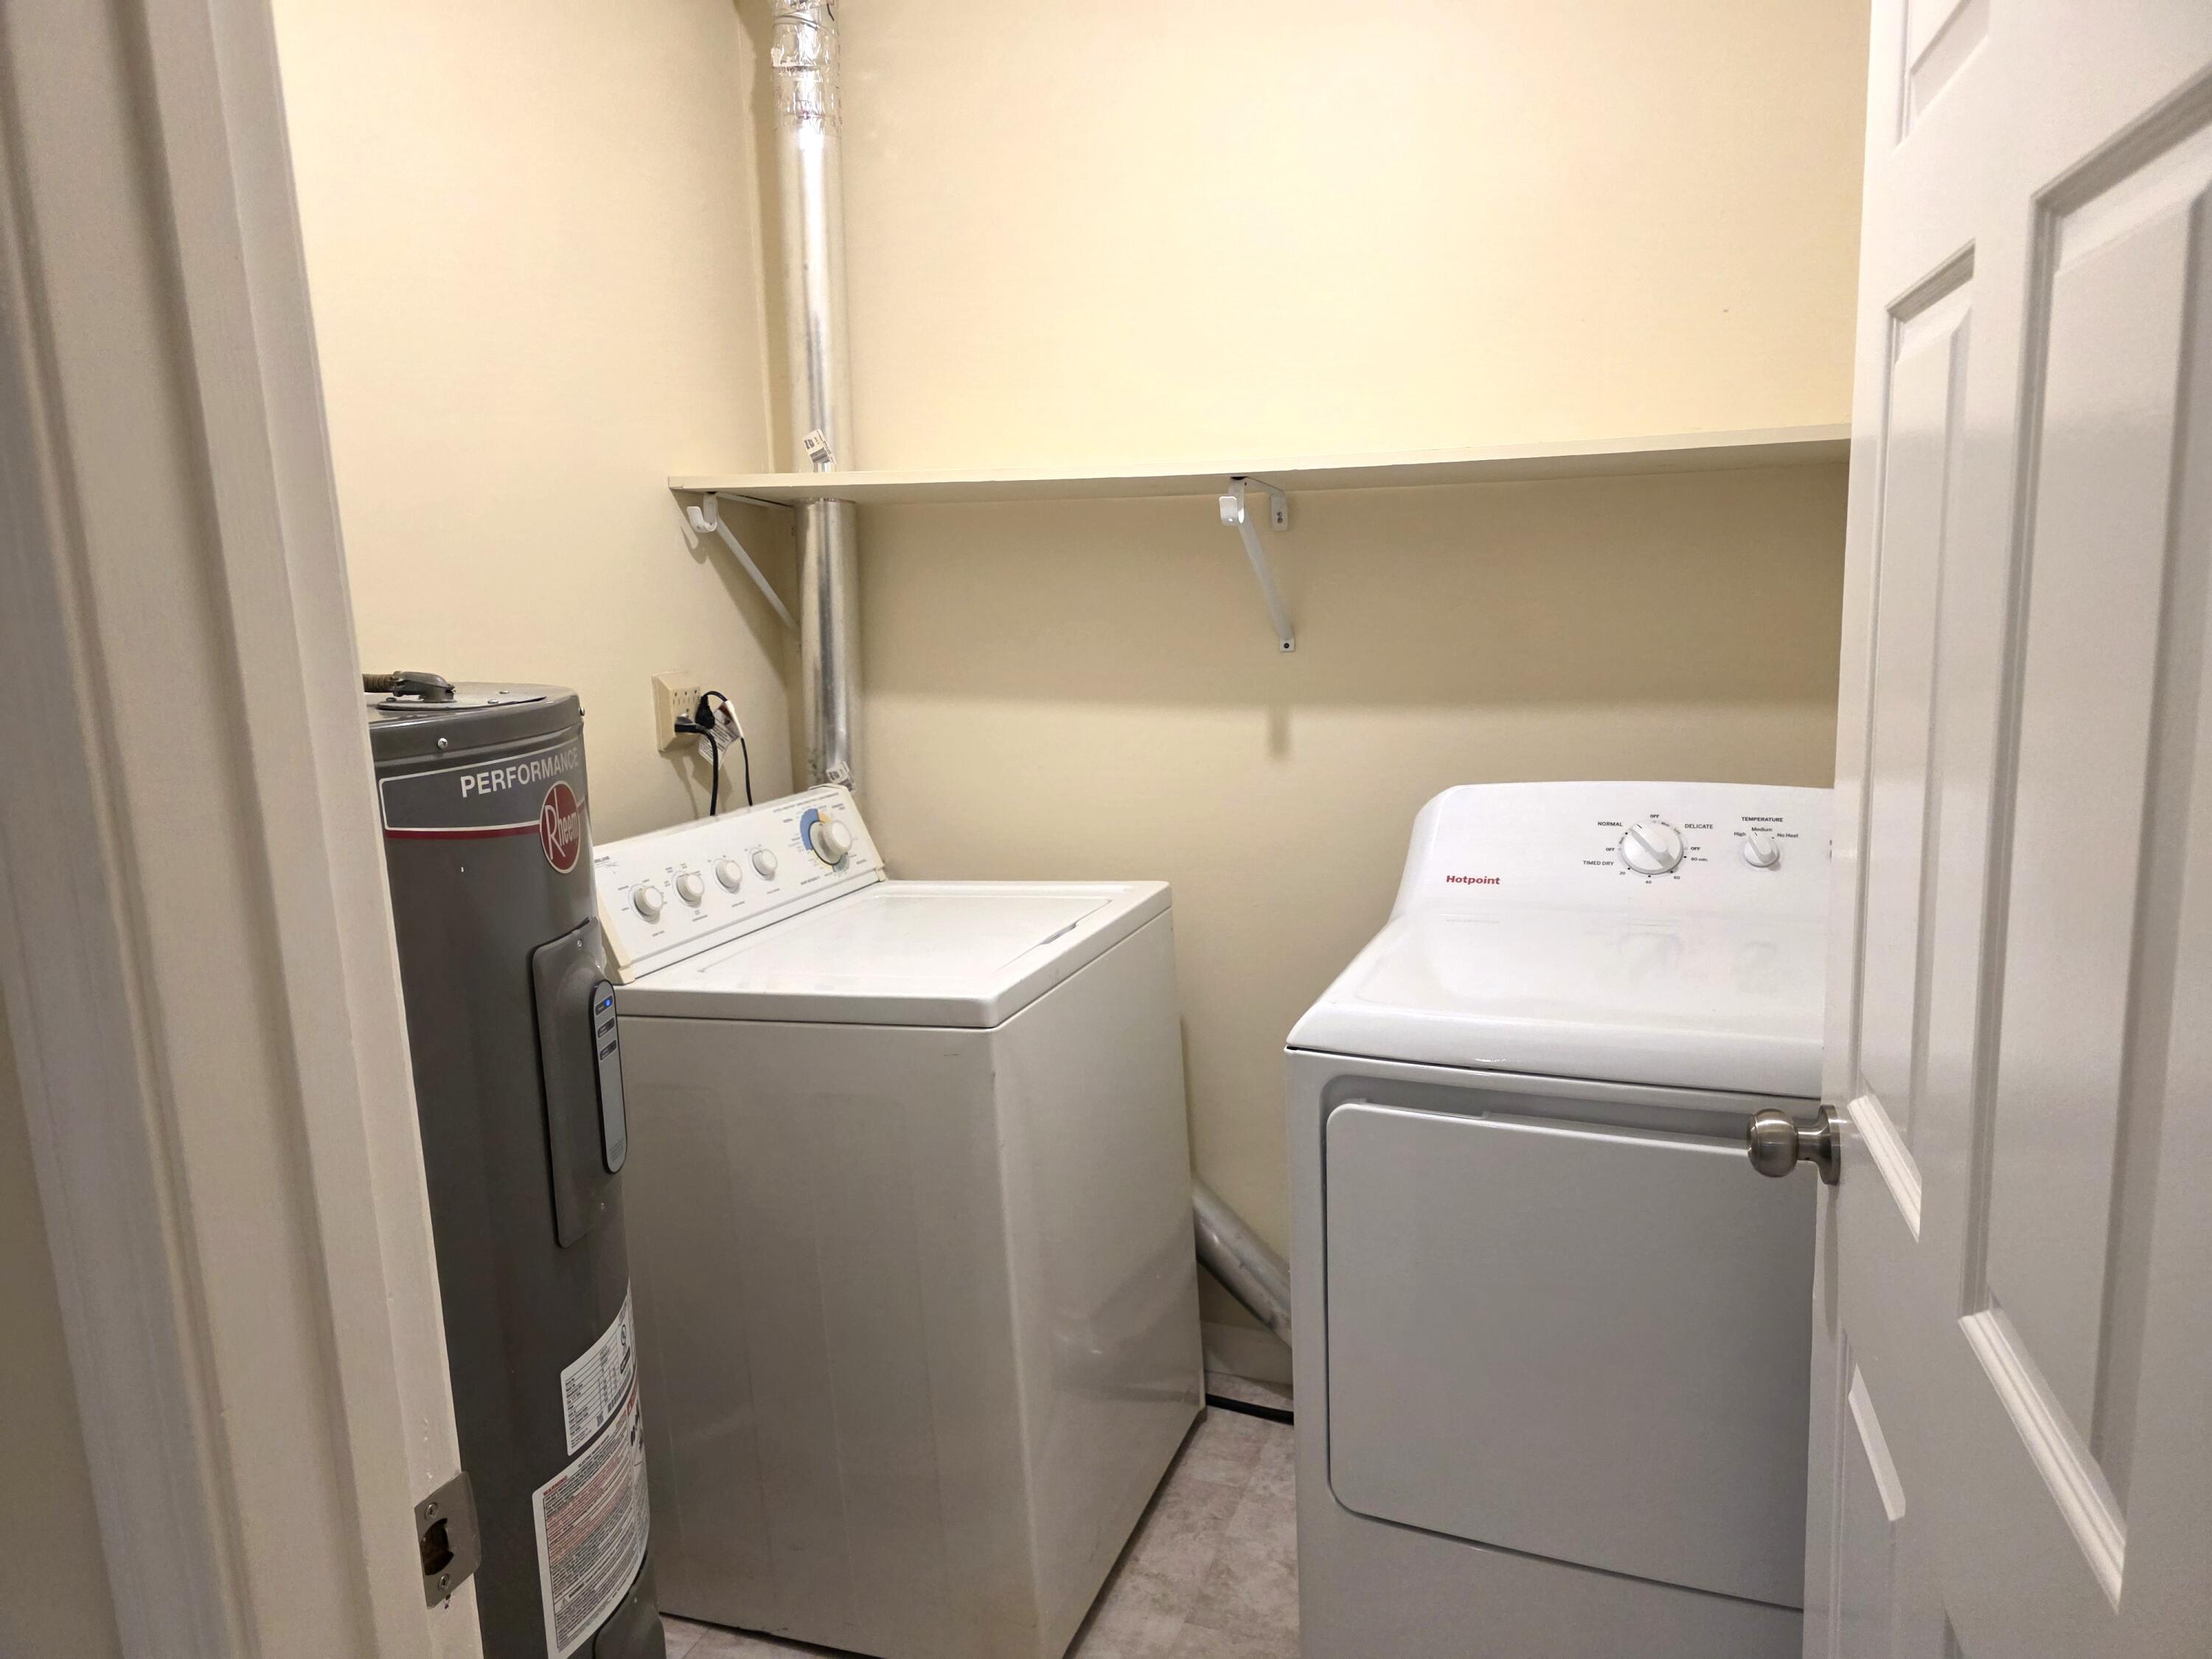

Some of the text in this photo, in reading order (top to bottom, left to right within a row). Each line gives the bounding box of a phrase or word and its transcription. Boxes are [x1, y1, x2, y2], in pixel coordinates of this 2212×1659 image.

[460, 747, 579, 799] PERFORMANCE
[544, 787, 578, 860] Rheem
[1446, 874, 1500, 885] Hotpoint
